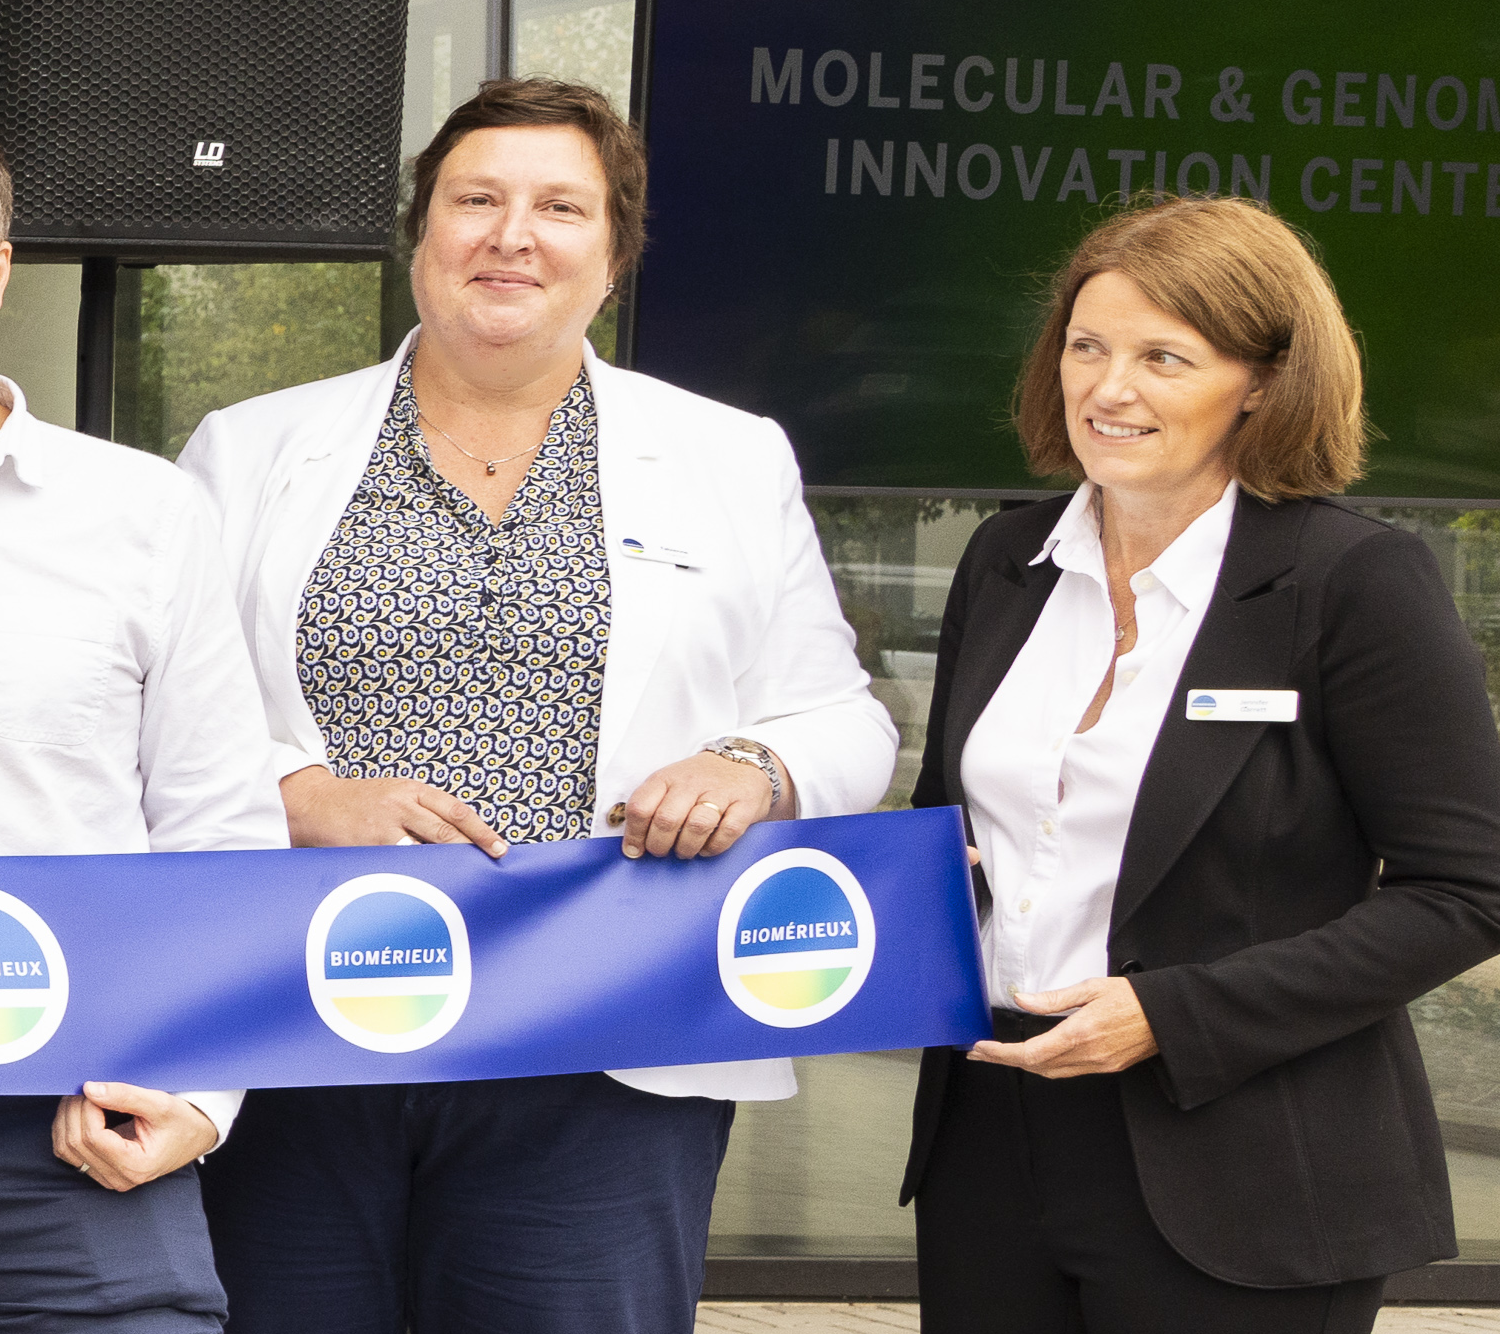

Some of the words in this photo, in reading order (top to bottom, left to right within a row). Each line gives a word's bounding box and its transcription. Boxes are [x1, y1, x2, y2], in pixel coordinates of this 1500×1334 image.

[751, 46, 1183, 121] MOLECULAR
[1209, 65, 1255, 123] &
[194, 142, 225, 159] LD
[824, 137, 1272, 206] INNOVATION
[740, 920, 852, 946] BIOMÉRIEUX
[330, 949, 448, 967] BIOMÉRIEUX
